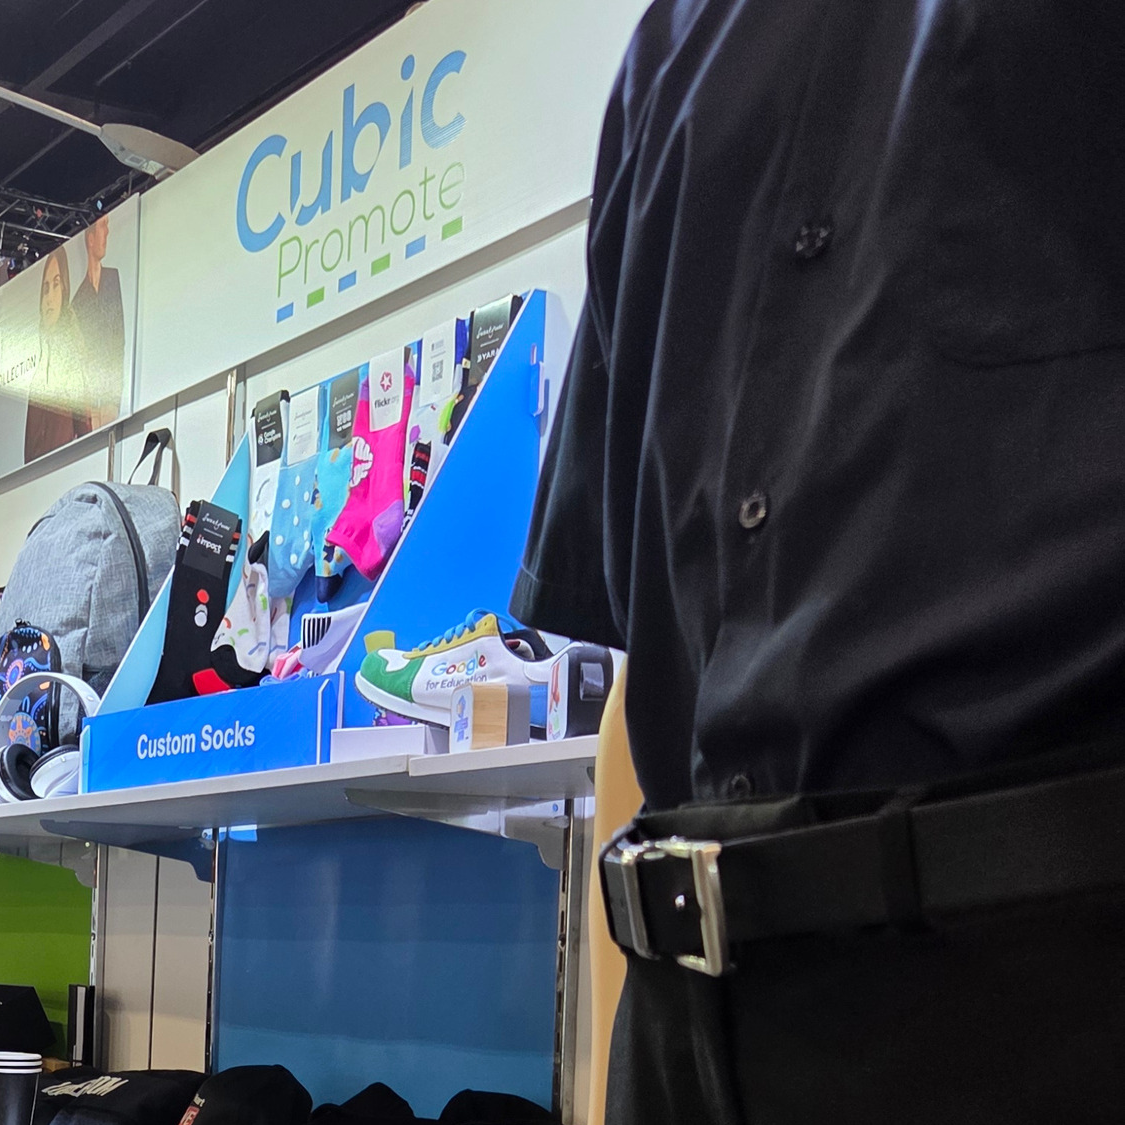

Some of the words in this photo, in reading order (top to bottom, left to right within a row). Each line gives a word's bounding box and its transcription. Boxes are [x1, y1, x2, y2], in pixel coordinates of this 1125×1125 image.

[236, 50, 467, 253] Cubic
[277, 162, 466, 298] Promote
[431, 650, 487, 676] Google
[426, 680, 440, 690] for
[137, 731, 196, 760] Custom
[200, 720, 255, 751] Socks
